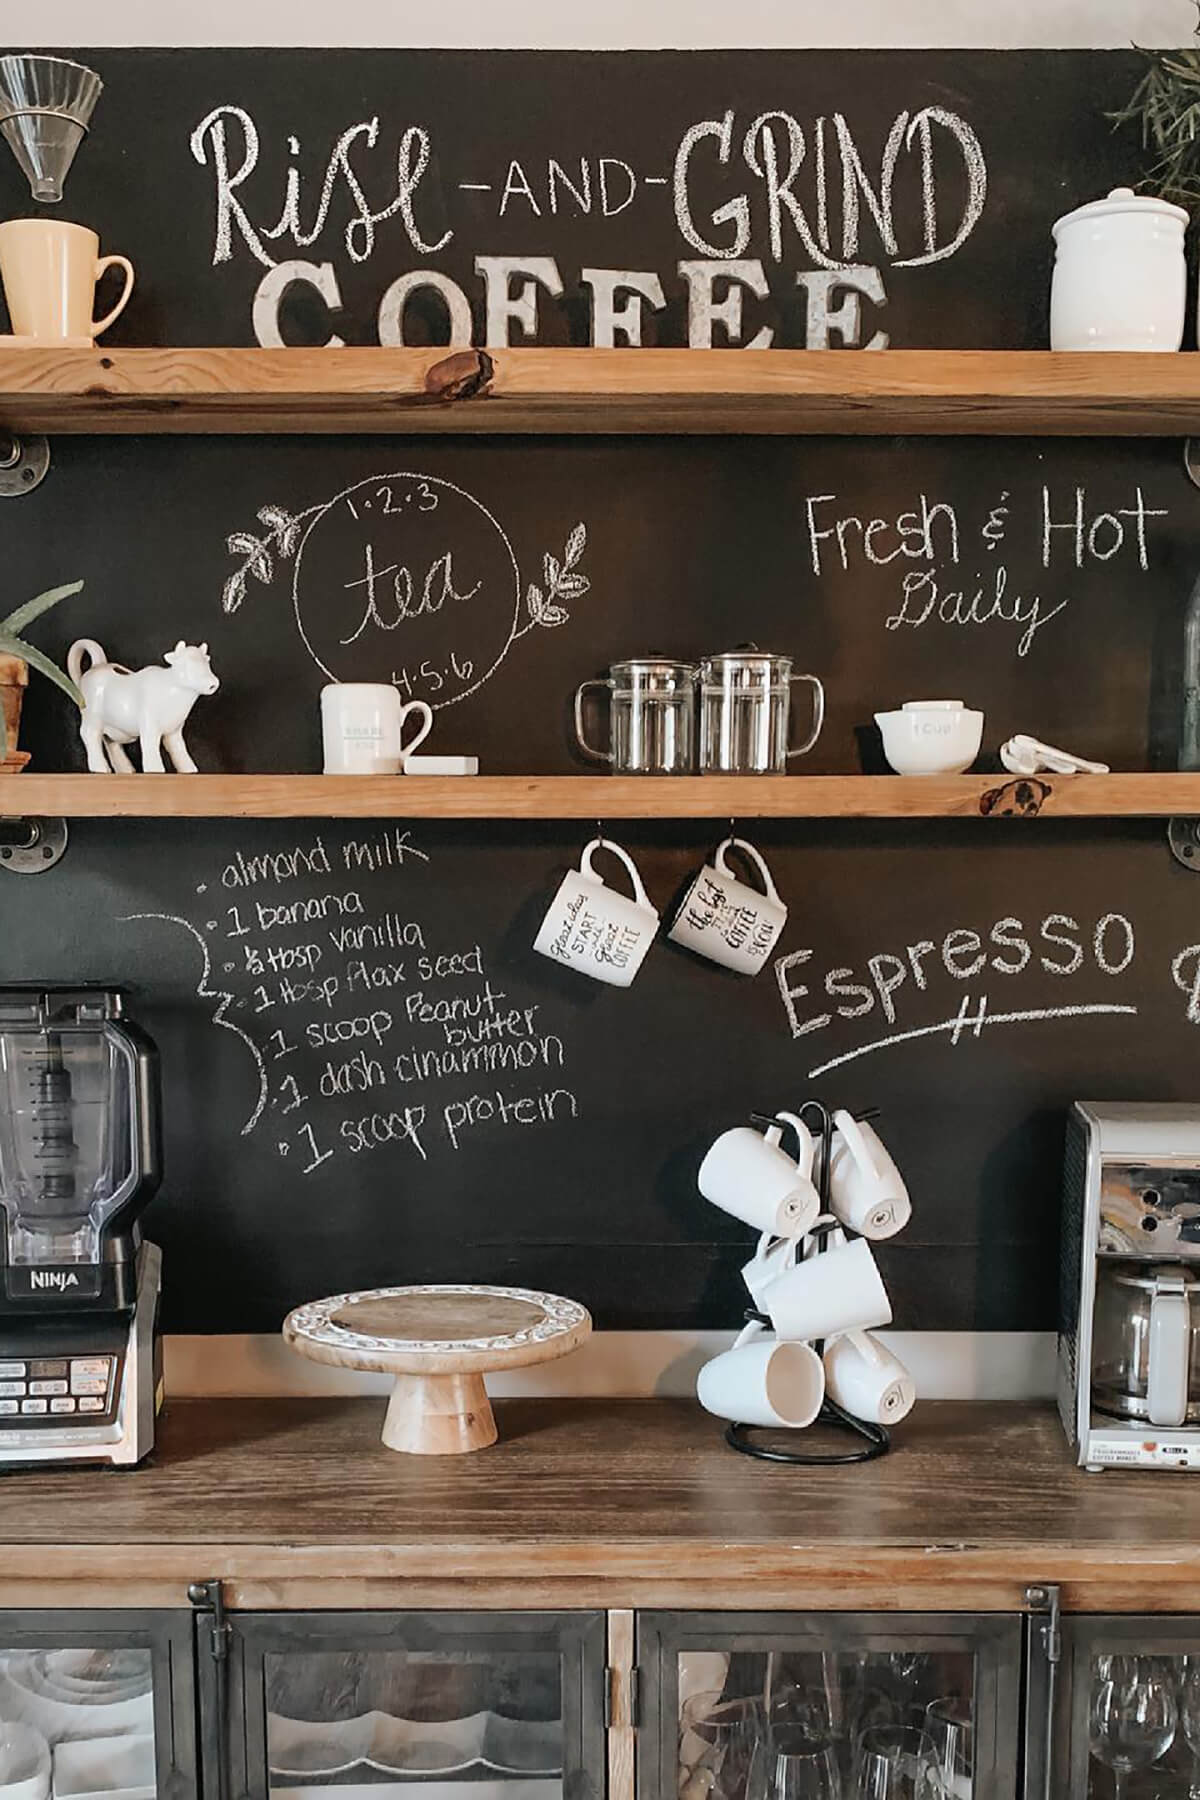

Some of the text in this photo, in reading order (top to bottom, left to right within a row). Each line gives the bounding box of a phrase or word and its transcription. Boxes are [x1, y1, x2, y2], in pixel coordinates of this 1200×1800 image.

[190, 105, 454, 266] Rise
[673, 105, 988, 270] GRIND
[252, 256, 891, 349] COFFEE
[806, 485, 1169, 576] Fresh & Hot
[339, 543, 483, 645] tea
[885, 565, 1070, 657] Daily
[222, 827, 430, 888] almond milk
[227, 891, 365, 937] 1 banana
[329, 913, 427, 953] vanilla
[571, 911, 597, 954] START
[724, 906, 758, 949] COFFEE
[254, 985, 276, 1013] 1
[417, 944, 484, 981] seed
[773, 912, 1135, 1040] Espresso
[269, 1029, 298, 1060] 1
[306, 1010, 393, 1049] scoop
[443, 1004, 541, 1048] butter
[280, 1074, 310, 1115] 1
[319, 1049, 386, 1097] dash
[297, 1088, 579, 1174] 1 scoop protein
[29, 1269, 80, 1292] NINJA
